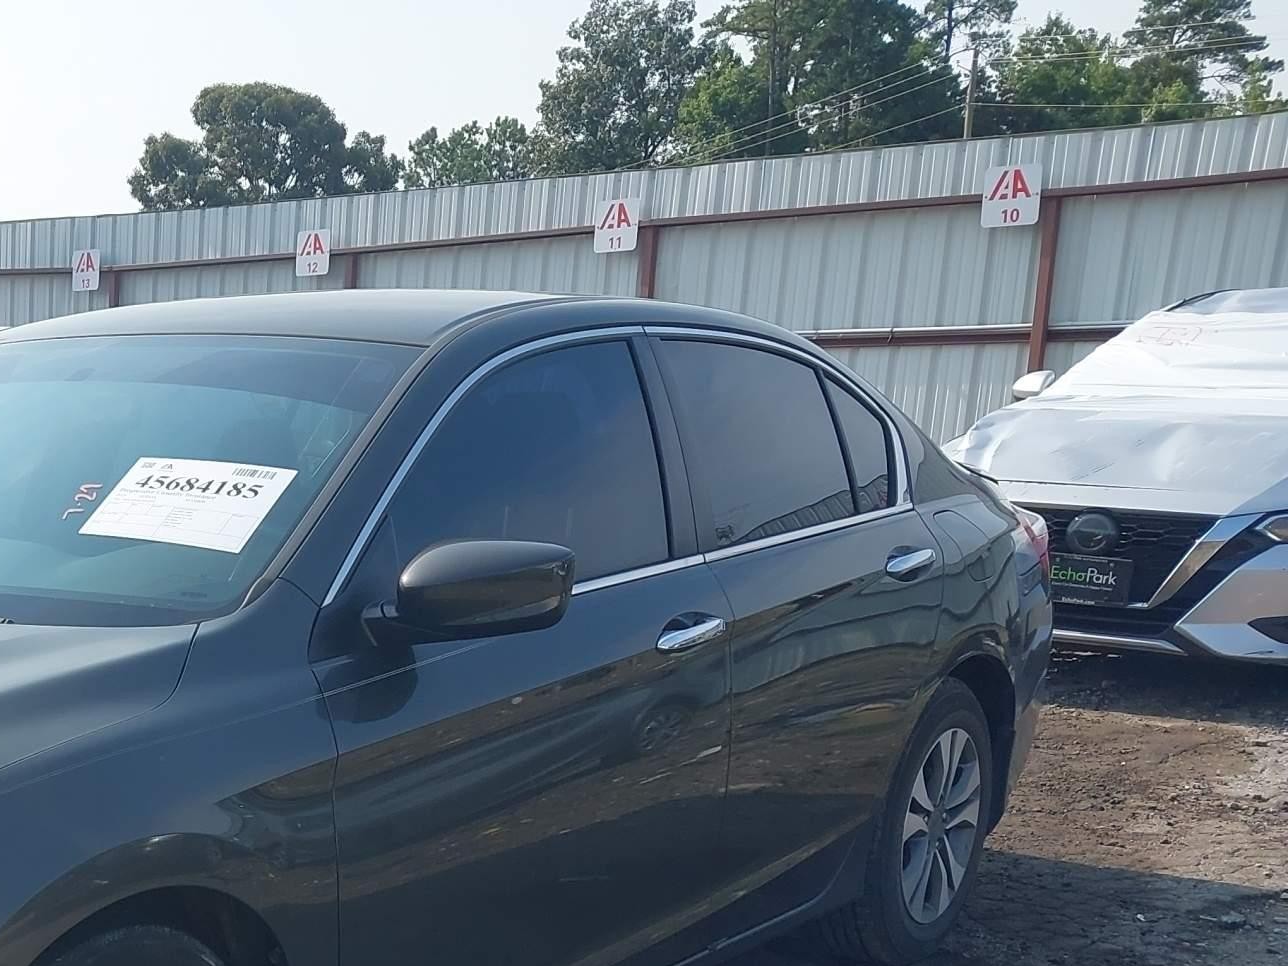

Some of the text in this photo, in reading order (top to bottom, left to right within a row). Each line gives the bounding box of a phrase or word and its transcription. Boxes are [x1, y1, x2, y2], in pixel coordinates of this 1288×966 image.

[1002, 208, 1020, 223] 10
[608, 236, 622, 249] 11
[307, 262, 318, 273] 12
[82, 278, 91, 289] 13
[135, 474, 264, 499] 45684185
[1050, 565, 1117, 585] EchoPark
